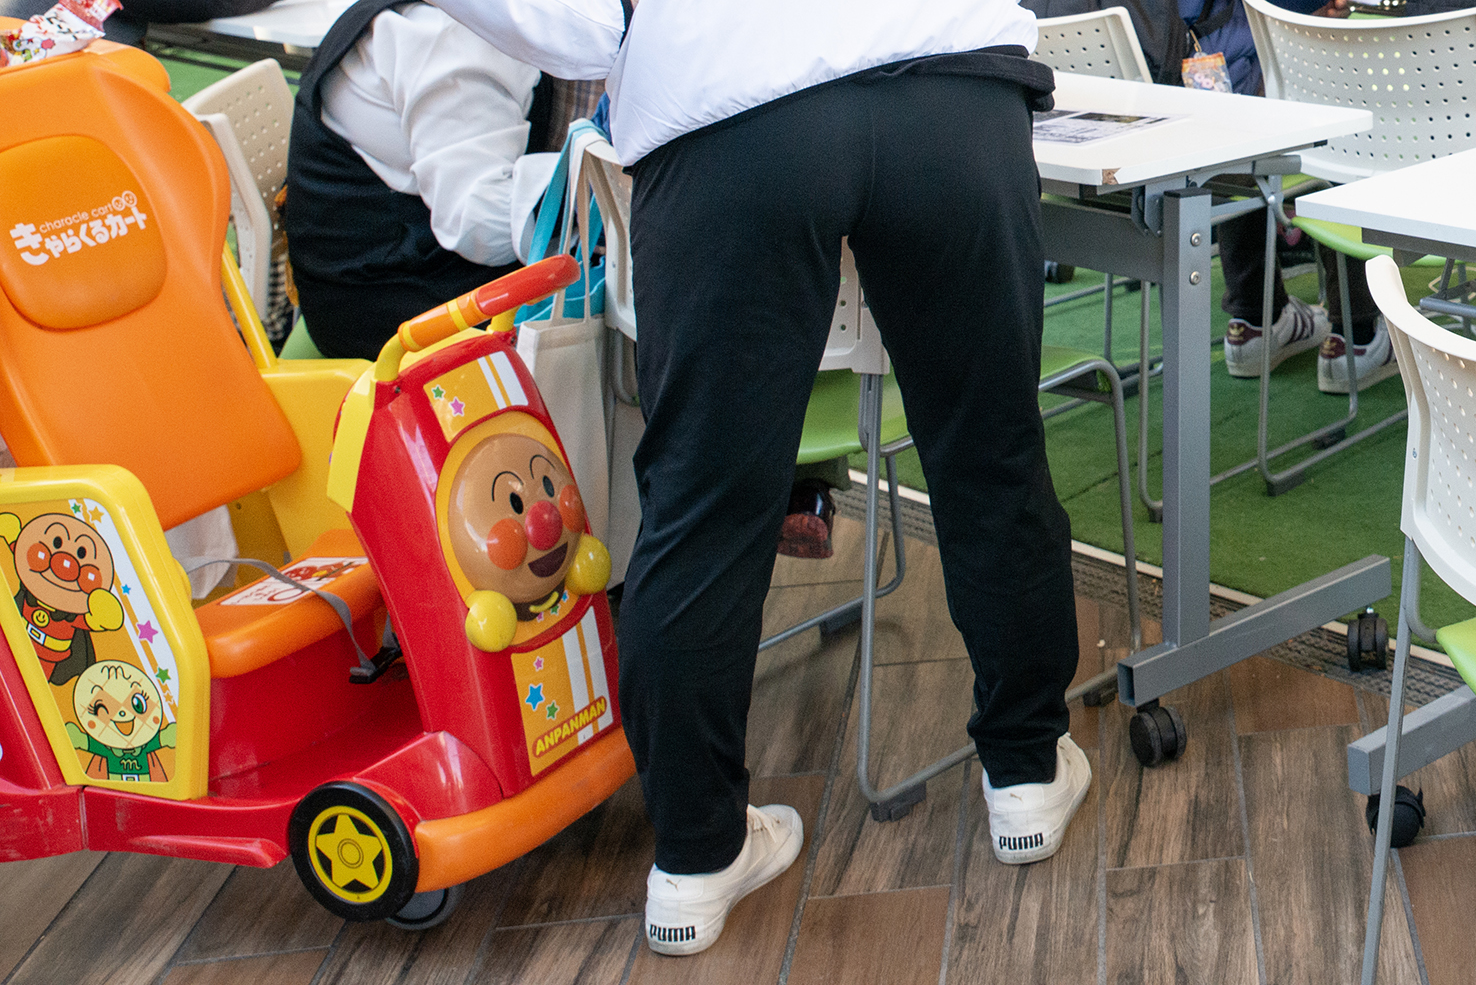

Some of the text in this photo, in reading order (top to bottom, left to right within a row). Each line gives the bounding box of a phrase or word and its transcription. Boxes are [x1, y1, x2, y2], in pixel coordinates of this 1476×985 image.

[9, 207, 147, 266] きゃらくるカート
[536, 698, 605, 756] ANPANMAN
[999, 832, 1044, 851] PUMA
[650, 924, 696, 942] PUMA
